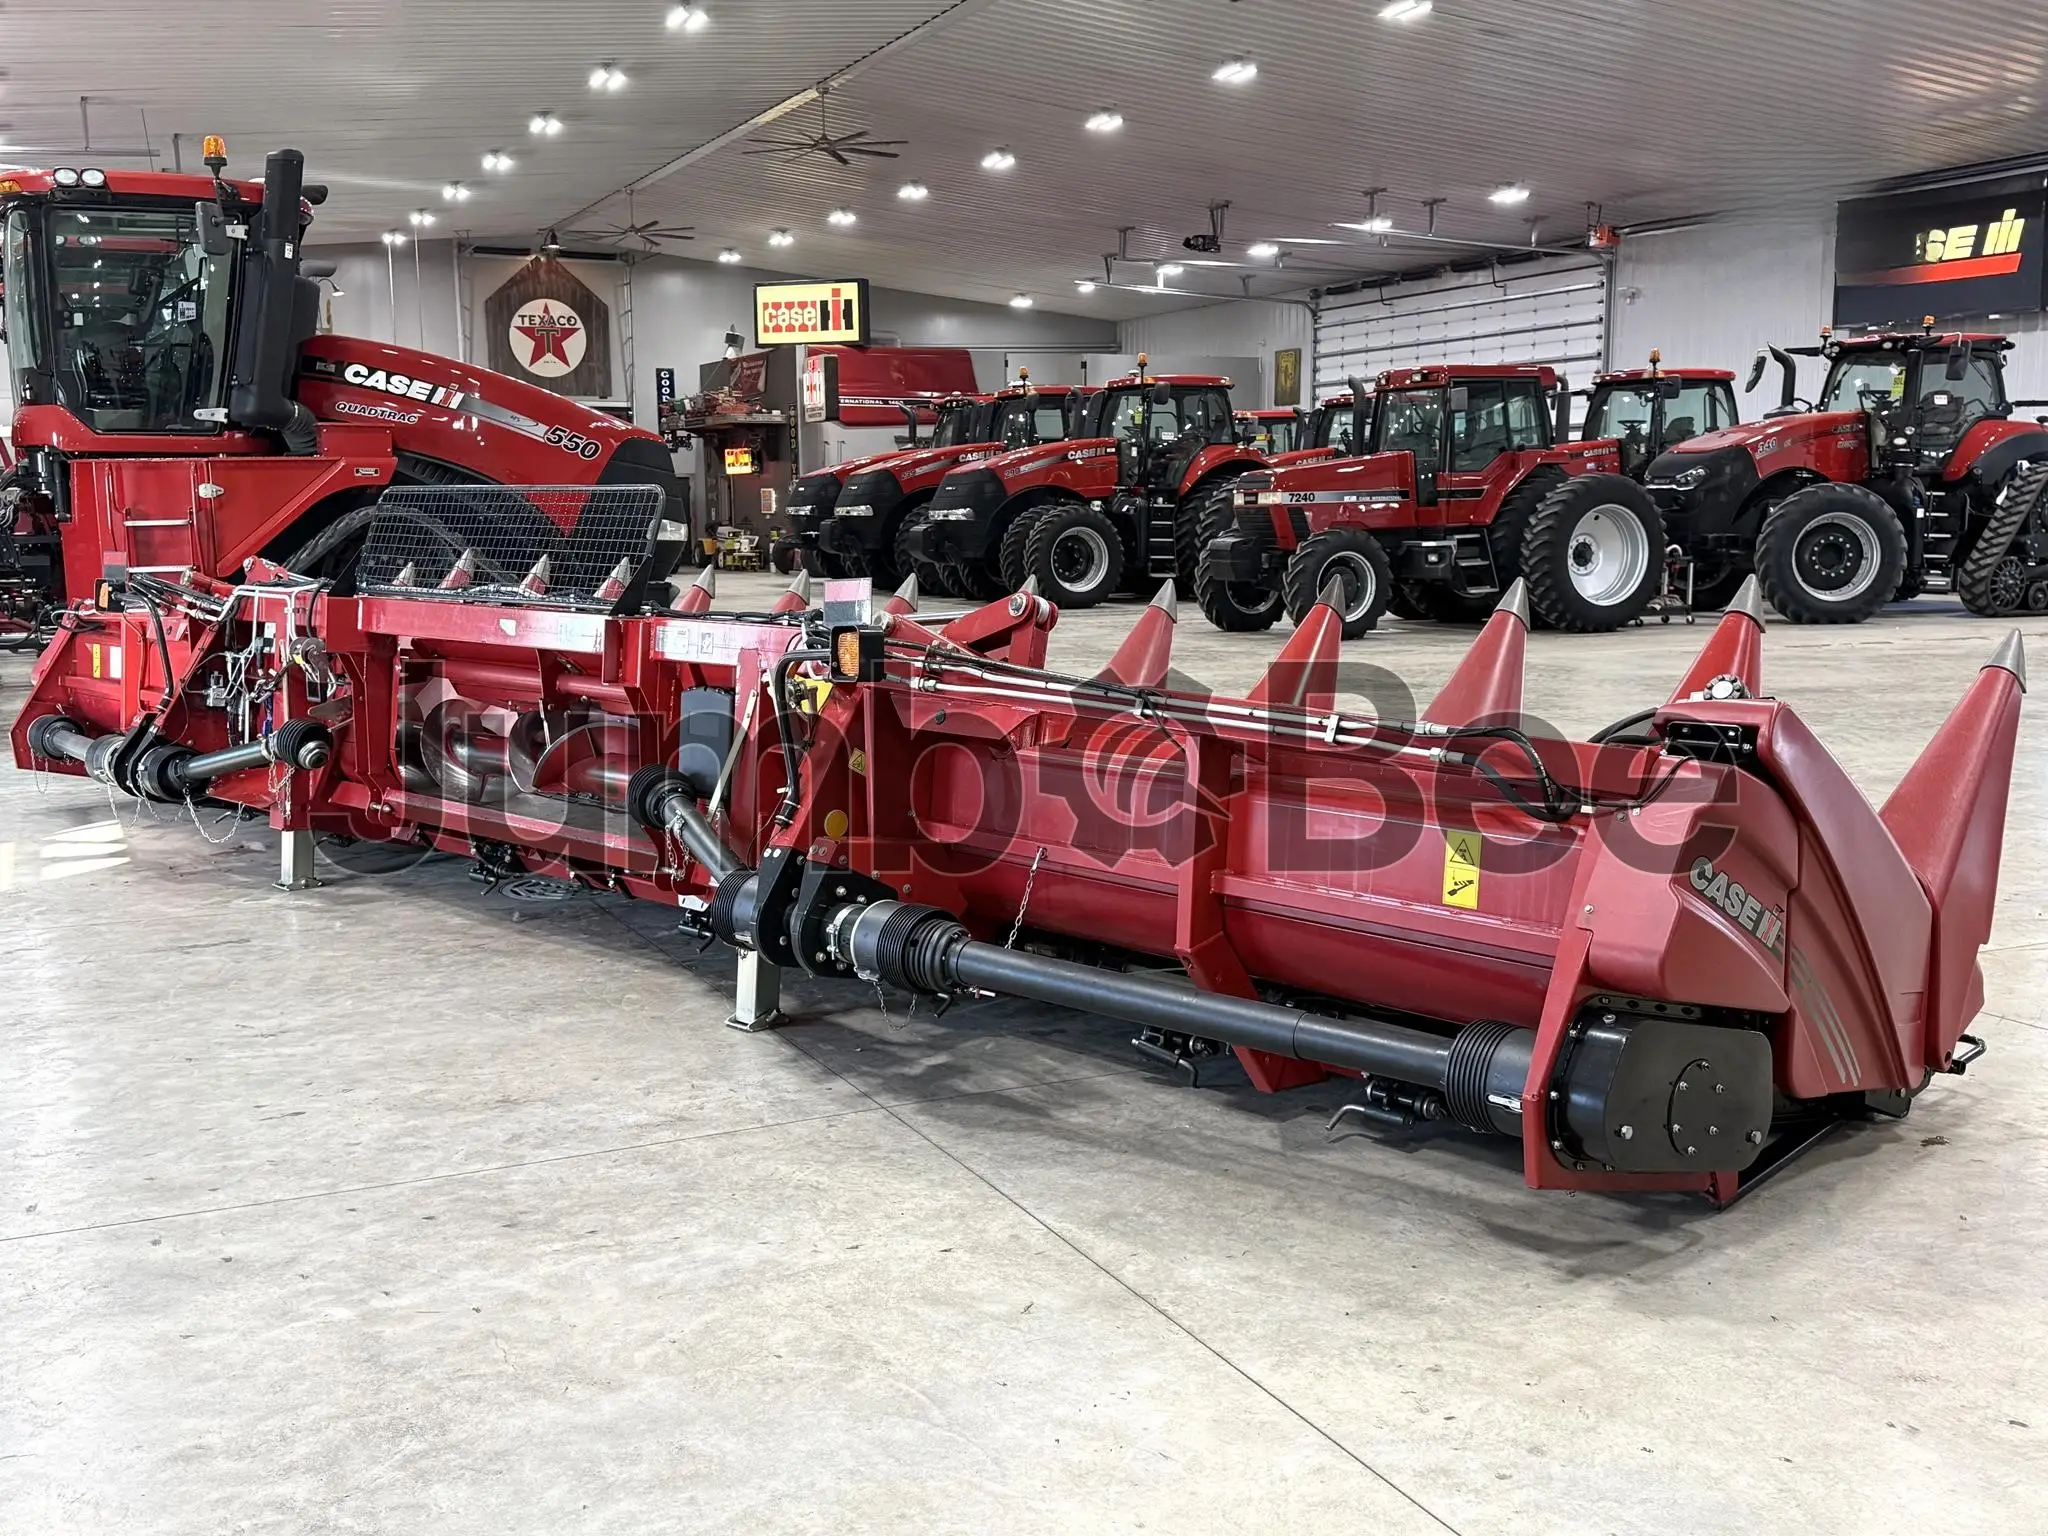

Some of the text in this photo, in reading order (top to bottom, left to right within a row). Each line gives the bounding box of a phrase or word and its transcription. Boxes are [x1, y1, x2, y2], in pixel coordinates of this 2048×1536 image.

[1916, 225, 1978, 264] SE
[518, 314, 577, 327] TEXACO
[535, 328, 560, 354] T
[344, 363, 465, 410] CASE IH
[335, 401, 419, 424] QUADTRAC
[544, 425, 602, 461] 550
[1068, 449, 1095, 460] CASE
[959, 451, 985, 462] CASE
[1288, 492, 1315, 503] 7240
[1689, 855, 1761, 931] CASE
